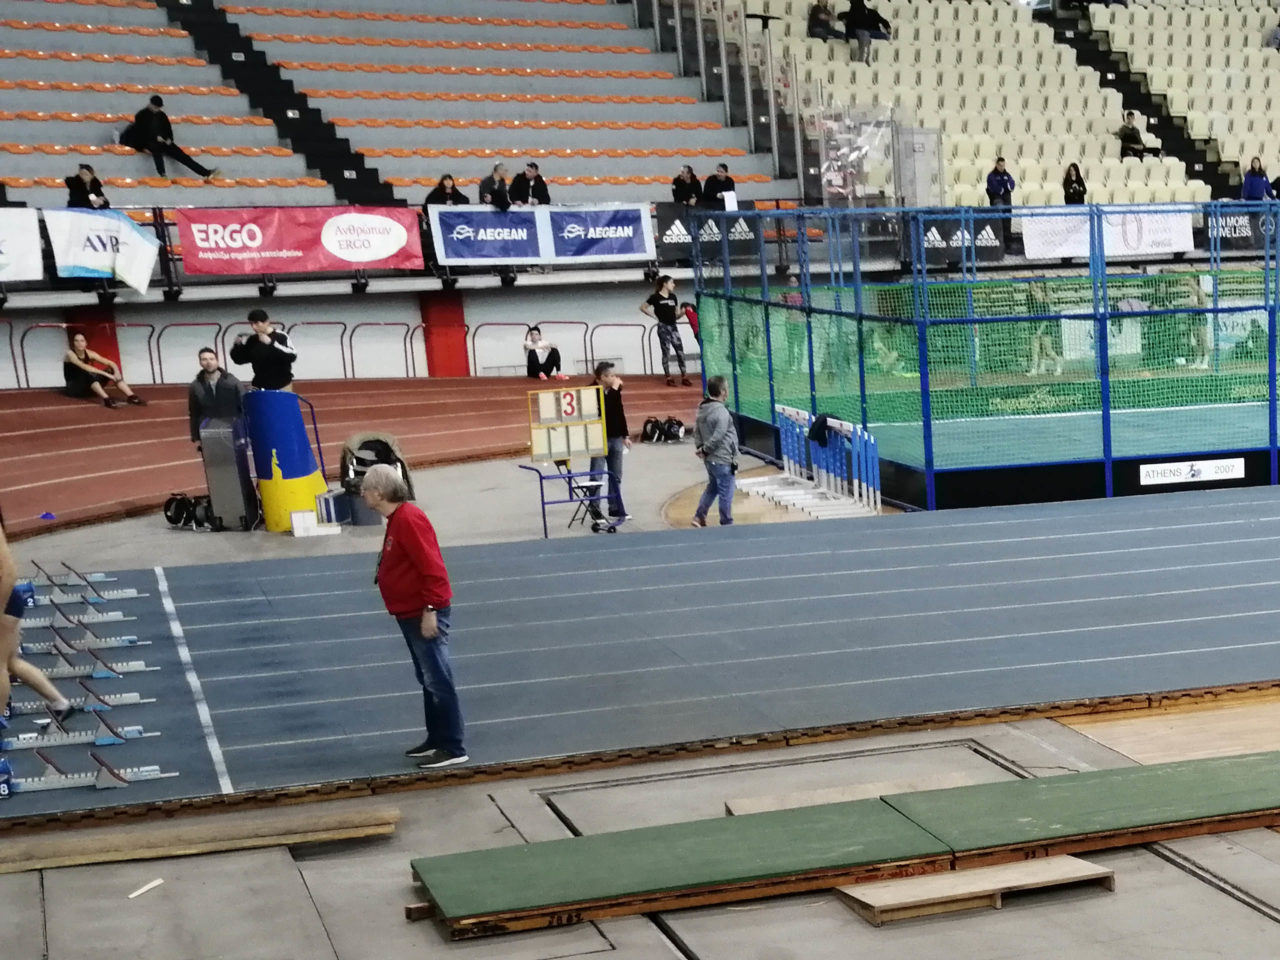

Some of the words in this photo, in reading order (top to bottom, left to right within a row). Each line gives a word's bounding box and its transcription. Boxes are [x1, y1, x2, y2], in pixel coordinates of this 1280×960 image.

[1226, 215, 1250, 227] MORE
[190, 223, 263, 249] ERGO
[477, 228, 528, 241] AEGEAN
[587, 226, 633, 239] AEGEAN
[1231, 226, 1251, 238] LESS
[338, 239, 371, 250] ERGO
[562, 391, 576, 416] 3
[1144, 467, 1182, 479] ATHENS
[1214, 464, 1235, 474] 2007
[27, 597, 34, 606] 2
[0, 784, 9, 795] 8
